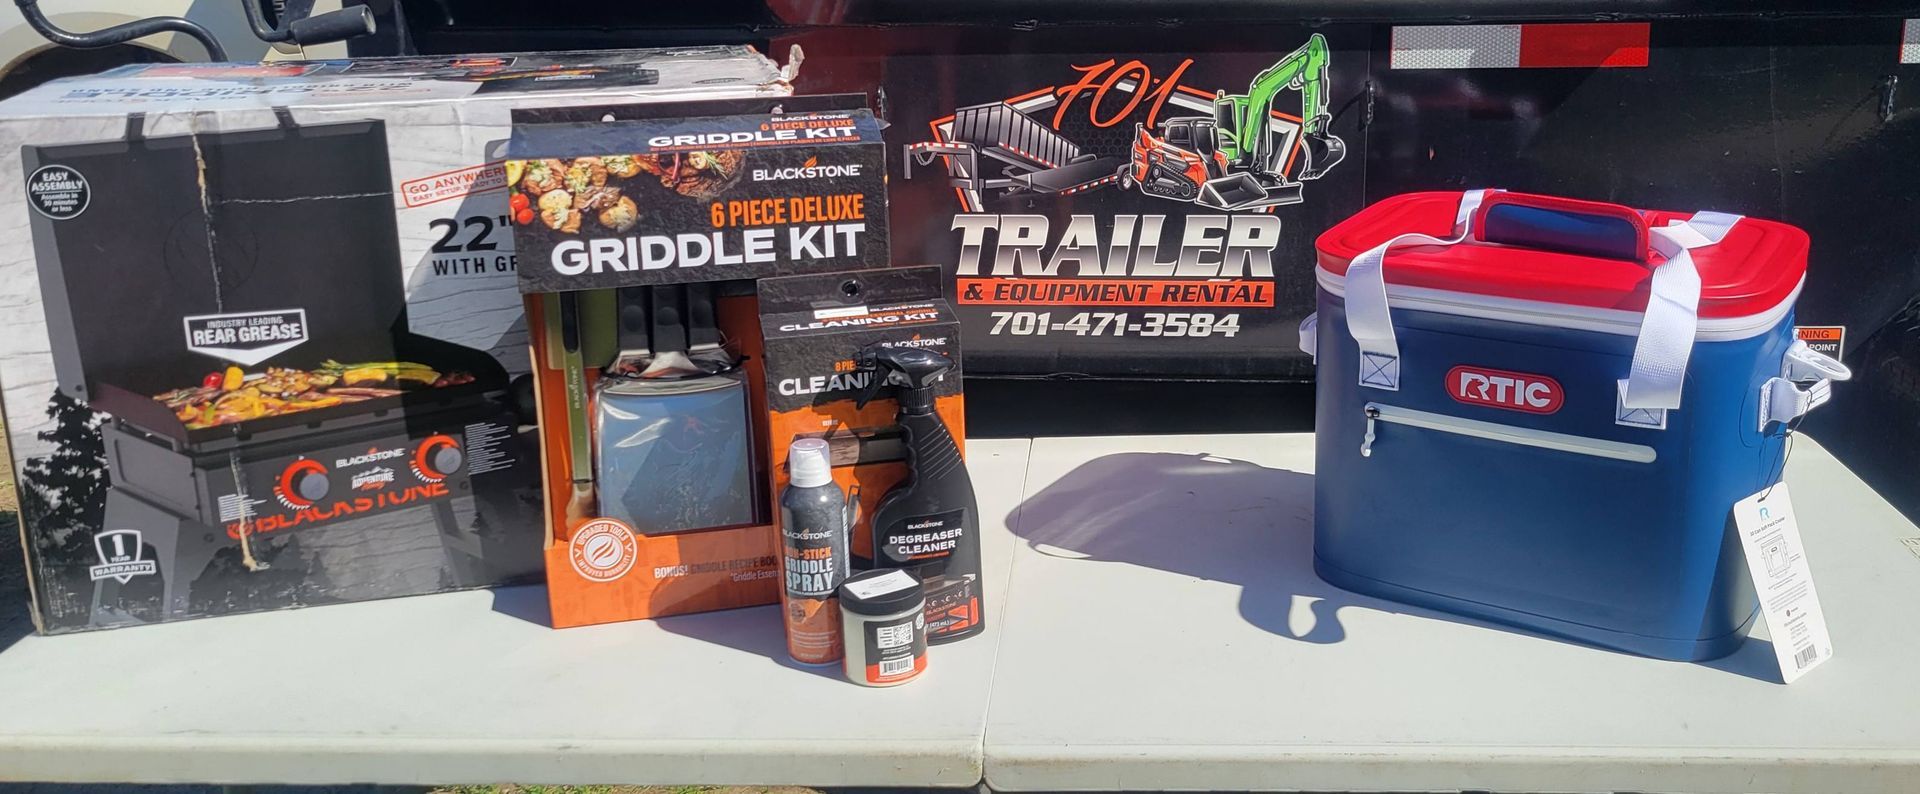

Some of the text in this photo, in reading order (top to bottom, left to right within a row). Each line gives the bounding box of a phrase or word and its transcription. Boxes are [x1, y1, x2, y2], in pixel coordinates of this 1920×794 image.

[1053, 58, 1194, 130] 701
[760, 118, 853, 131] 6 PIECE DELUXE
[771, 113, 851, 122] BLACKSTONE
[648, 130, 797, 147] GRIDDLE
[806, 126, 856, 138] KIT
[42, 171, 68, 181] EASY
[409, 166, 506, 194] GO ANYWHER
[753, 163, 861, 181] BLACKSTONE
[31, 180, 83, 192] ASSEMBLY
[413, 193, 433, 202] EASY
[711, 193, 865, 228] 6 PIECE DELUXE
[551, 222, 866, 276] GRIDDLE KIT
[951, 214, 1281, 277] TRAILER
[432, 257, 486, 276] WITH
[963, 283, 1267, 303] & EQUIPMENT RENTAL
[869, 303, 935, 312] BLACKSTONE
[207, 316, 283, 328] INDUSTRY LEADING
[779, 315, 900, 331] CLEANING
[903, 311, 939, 321] KIT
[989, 311, 1241, 337] 701-471-3584
[193, 323, 302, 346] REAR GREASE
[1800, 330, 1830, 338] NING
[1809, 343, 1837, 351] POINT
[834, 360, 857, 371] 8 PIE
[1460, 372, 1552, 408] RTIC
[335, 447, 406, 469] BLACKSTONE
[907, 520, 944, 530] BLACKSTONE
[576, 524, 628, 546] UPGRADED TOOLS
[889, 527, 963, 545] DEGREASER
[112, 534, 125, 556] 1
[897, 540, 956, 555] CLEANER
[110, 555, 131, 563] YEAR
[785, 556, 833, 574] GRIDDLE
[94, 564, 151, 577] WARRANTY
[654, 564, 689, 579] BONUS!
[786, 571, 834, 591] SPRAY
